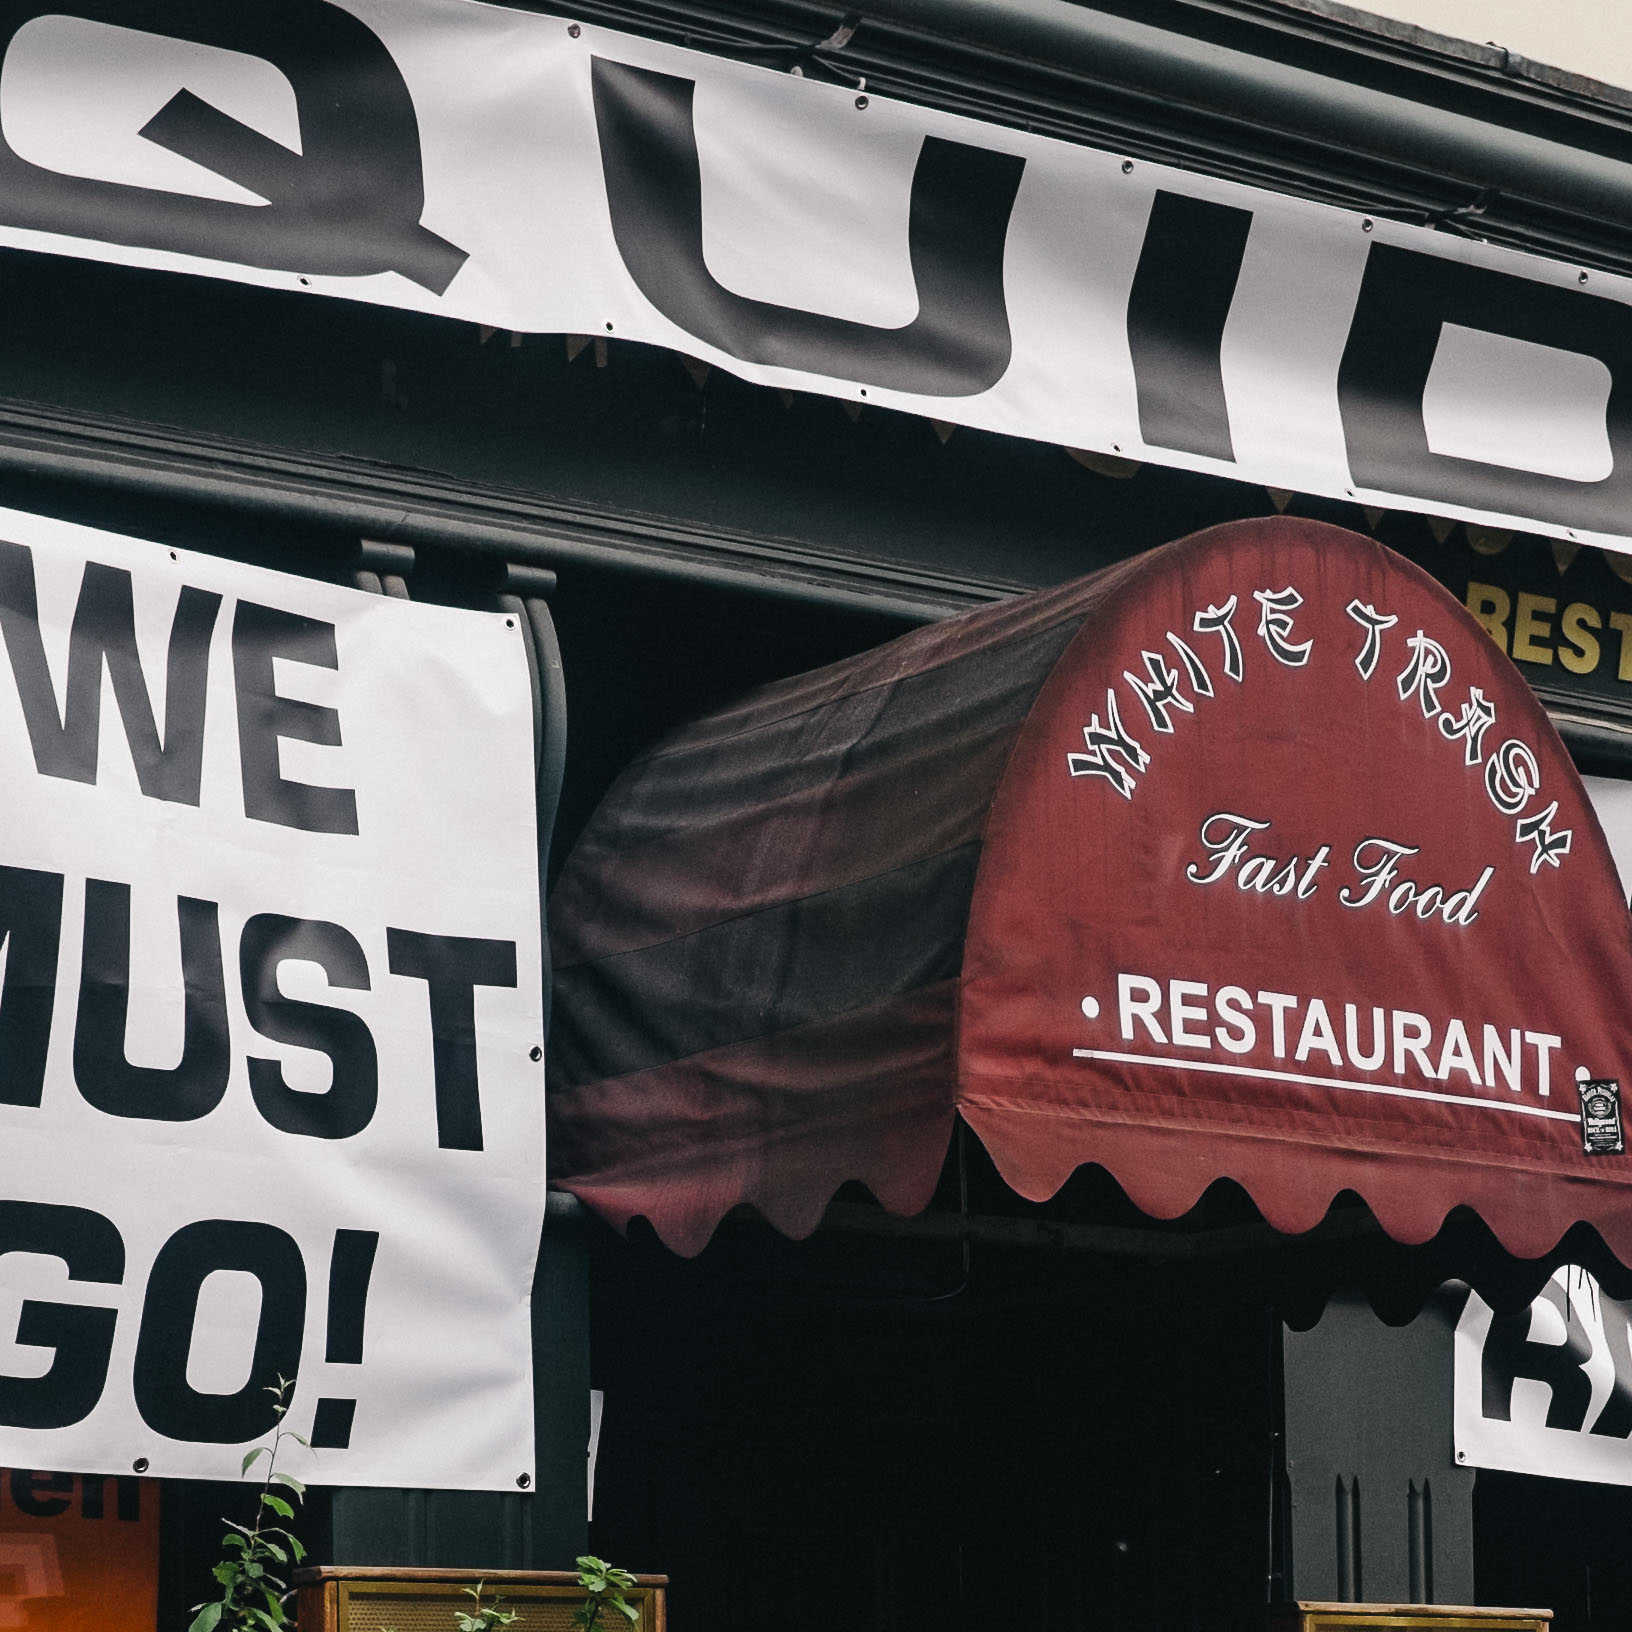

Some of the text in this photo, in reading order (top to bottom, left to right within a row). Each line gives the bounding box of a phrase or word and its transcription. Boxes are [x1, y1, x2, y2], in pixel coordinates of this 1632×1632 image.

[1068, 586, 1313, 800] WHITE
[1346, 598, 1572, 875] TRASH
[1185, 812, 1494, 927] Fast Food
[1116, 972, 1562, 1096] RESTAURANT
